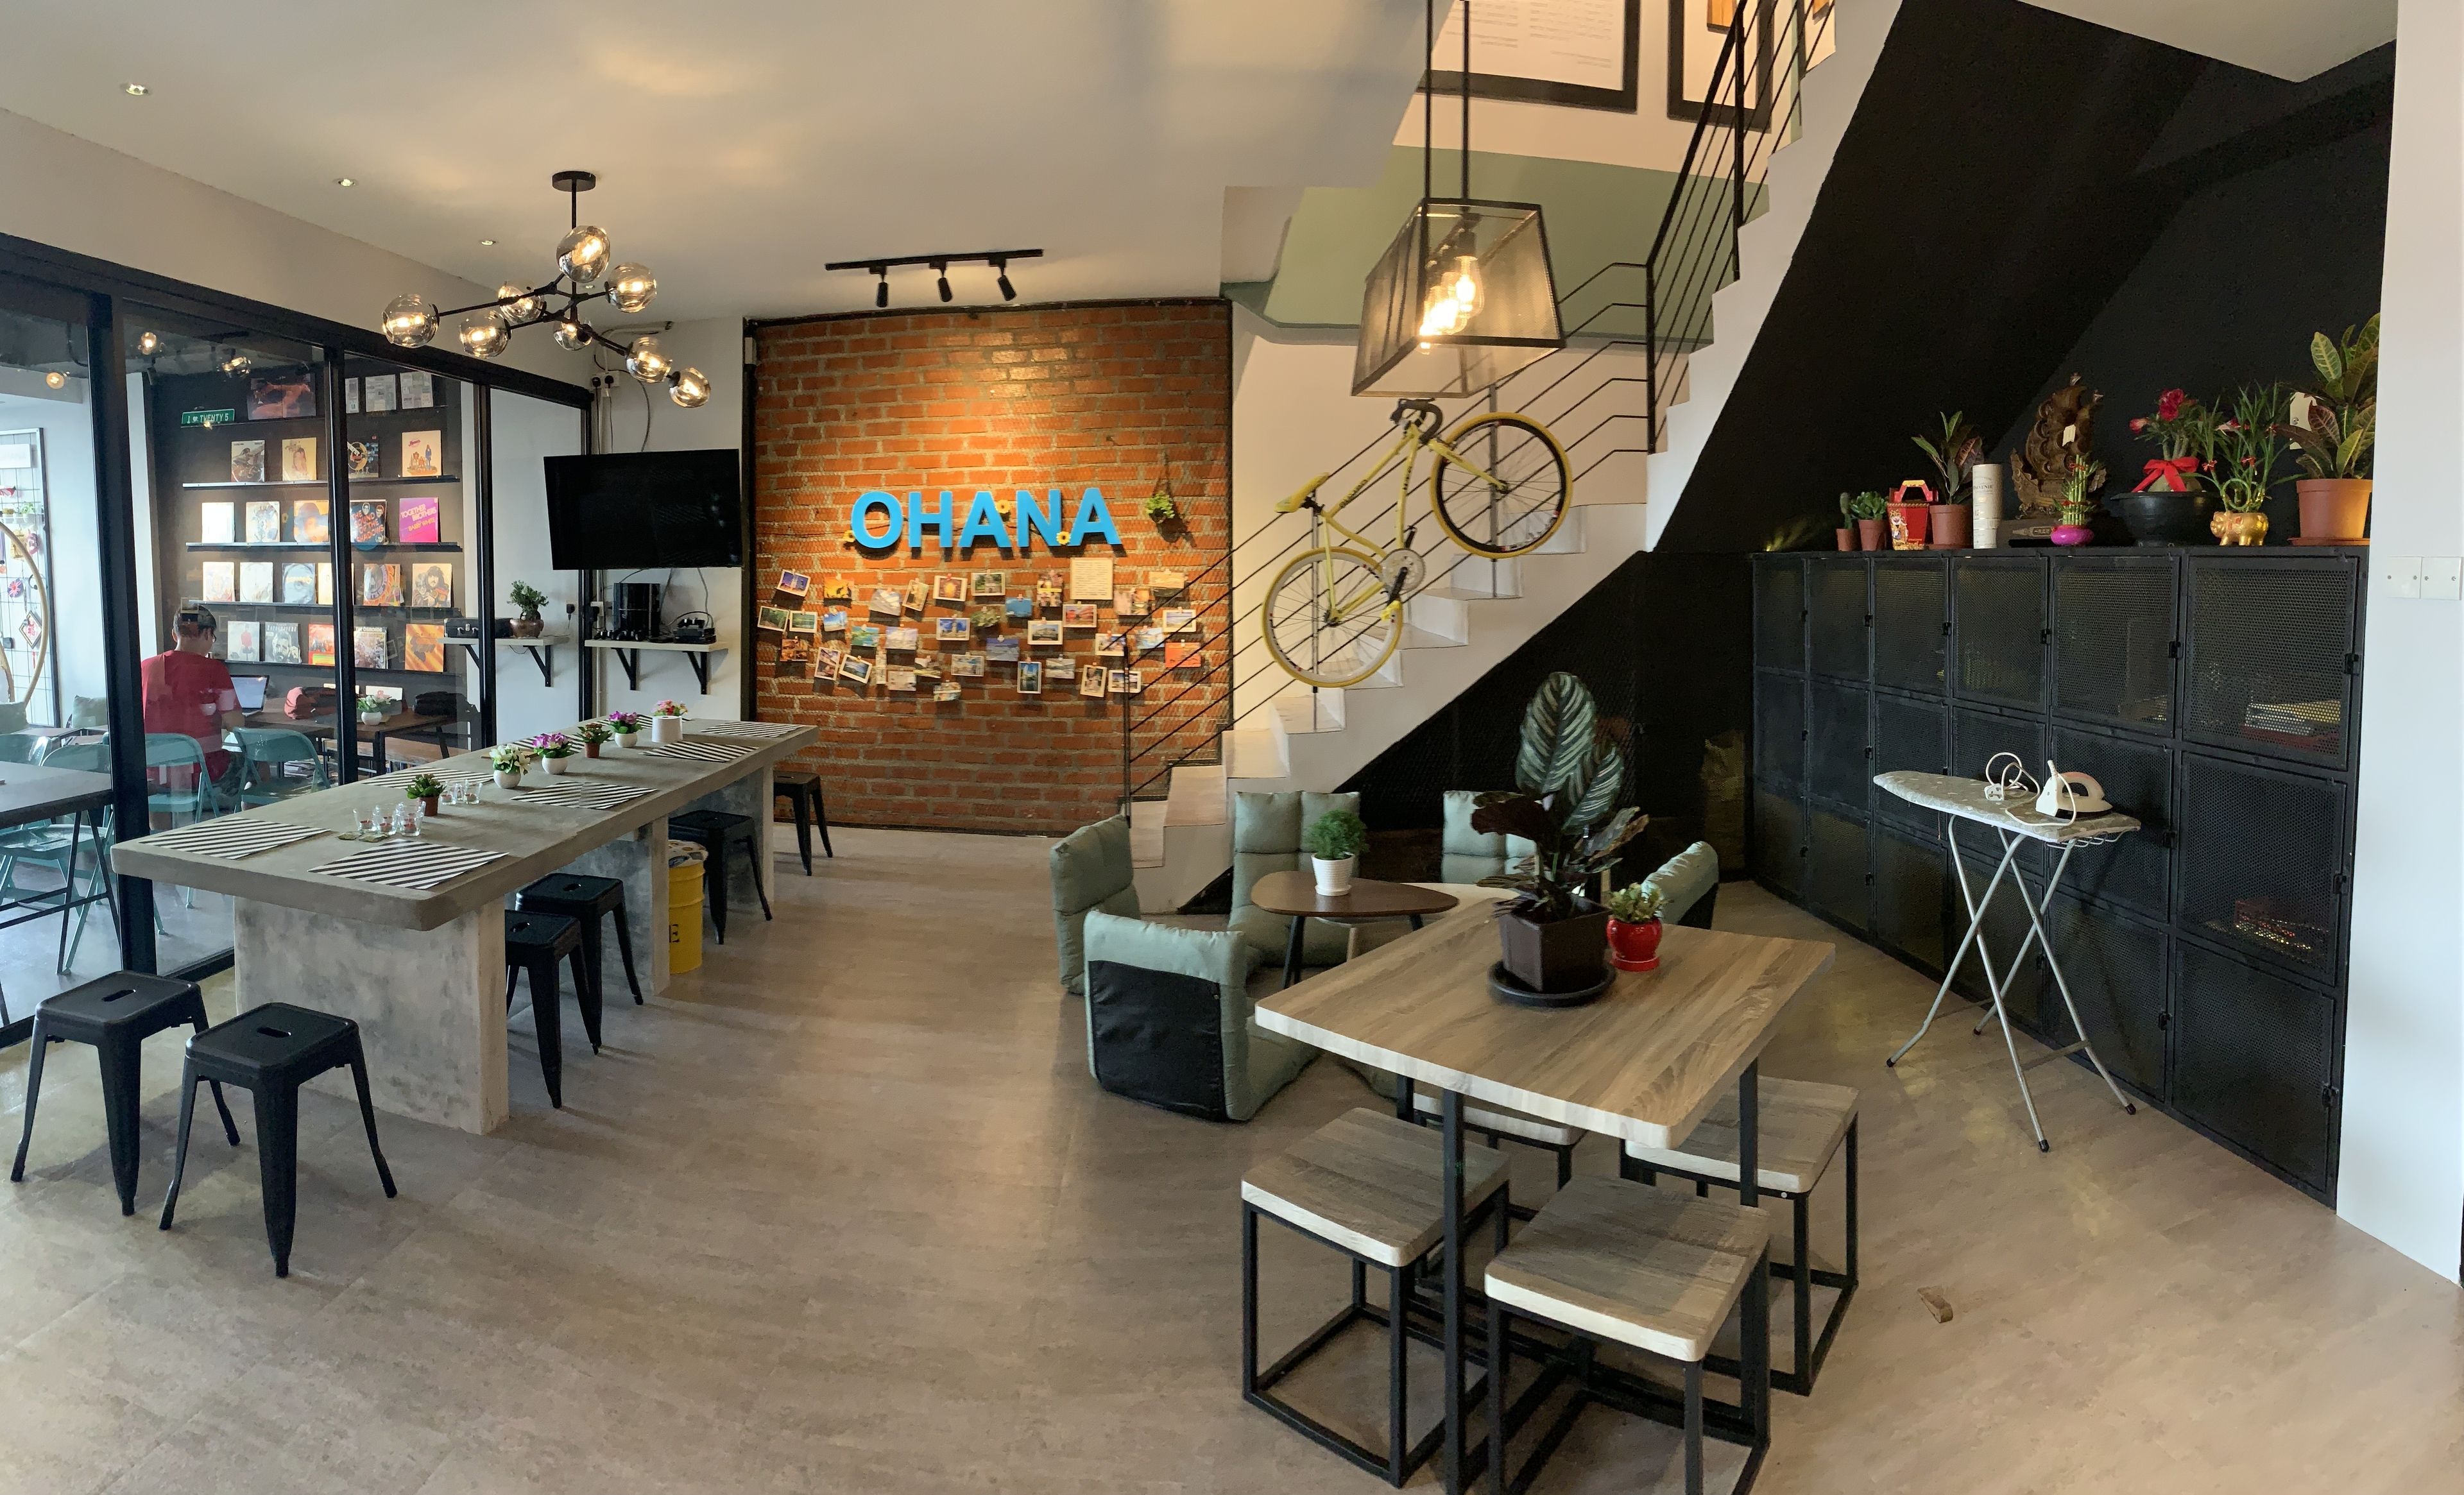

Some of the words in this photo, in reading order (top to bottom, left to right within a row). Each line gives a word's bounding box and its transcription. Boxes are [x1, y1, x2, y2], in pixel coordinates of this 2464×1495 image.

[200, 414, 224, 423] TWENTY
[400, 504, 426, 518] TOGETHER
[851, 488, 1122, 548] OHANA
